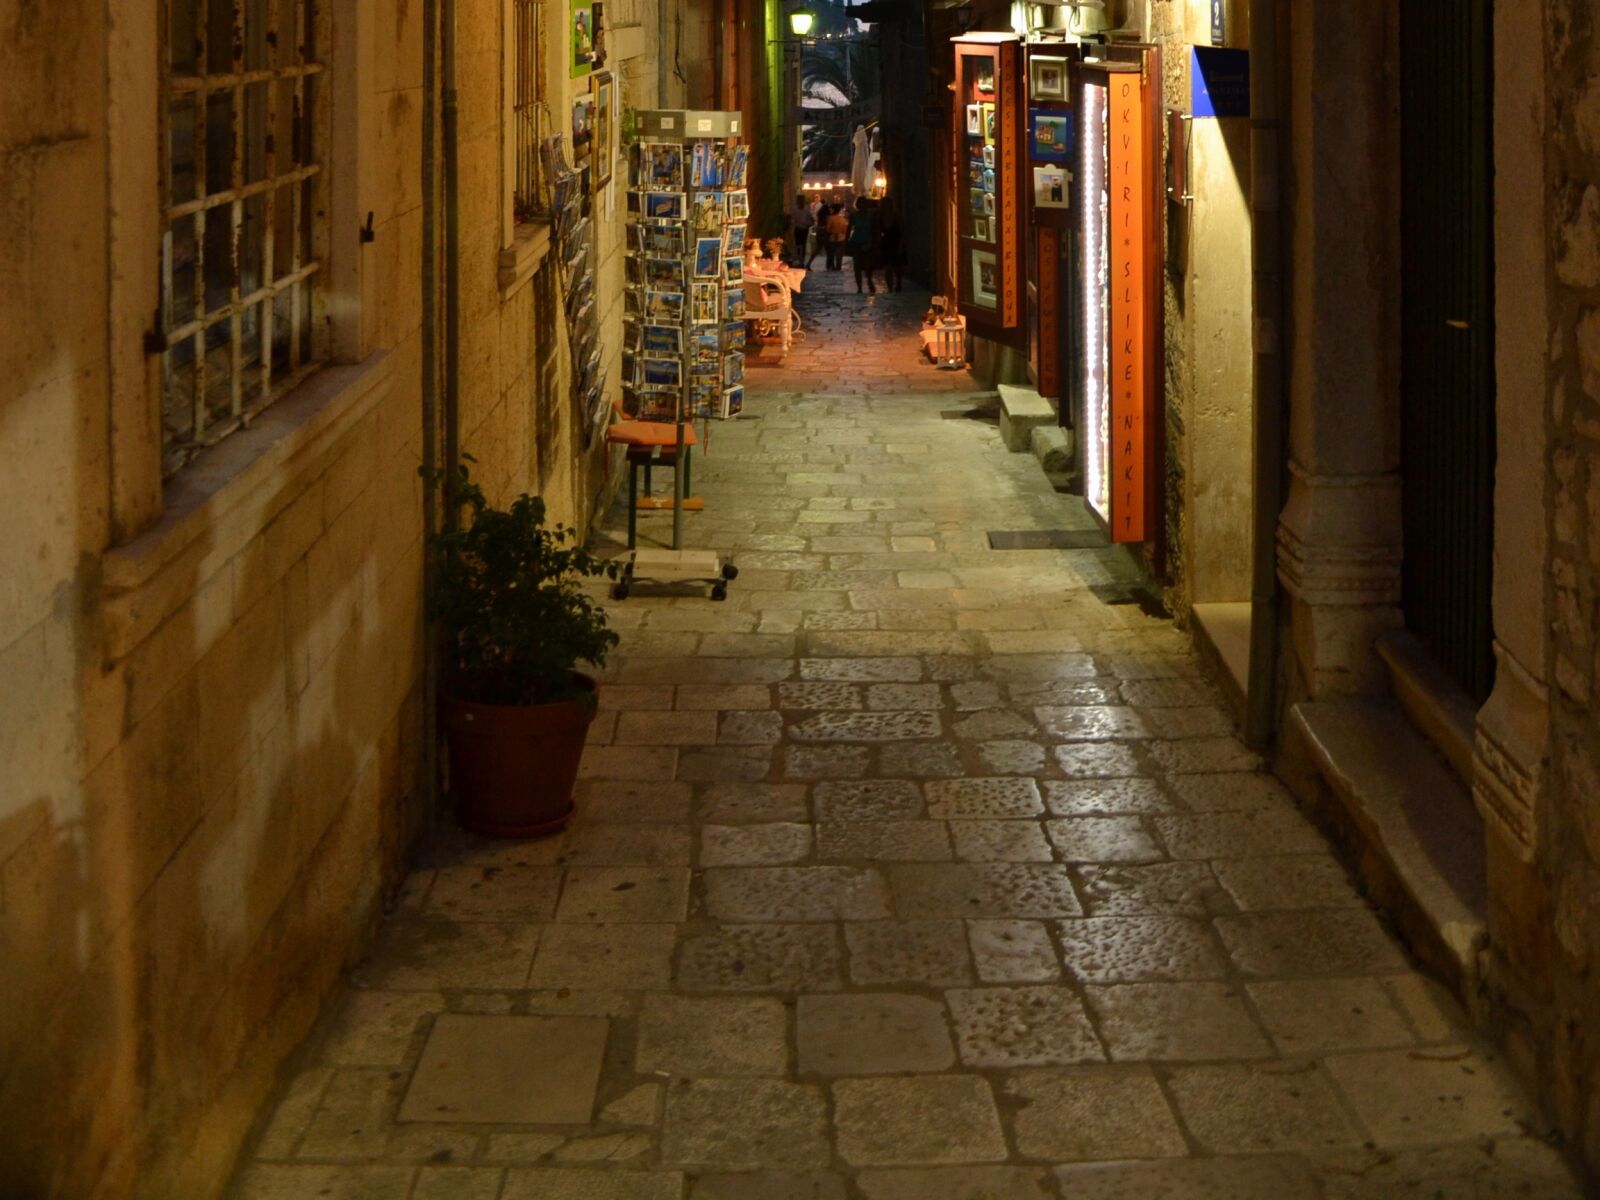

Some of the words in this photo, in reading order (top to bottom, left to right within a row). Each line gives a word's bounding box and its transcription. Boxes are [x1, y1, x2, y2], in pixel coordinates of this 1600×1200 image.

[1213, 0, 1221, 27] 2
[1121, 83, 1131, 228] OKVIRI
[1123, 262, 1132, 381] SLIKE
[1123, 415, 1133, 532] NAKIT
